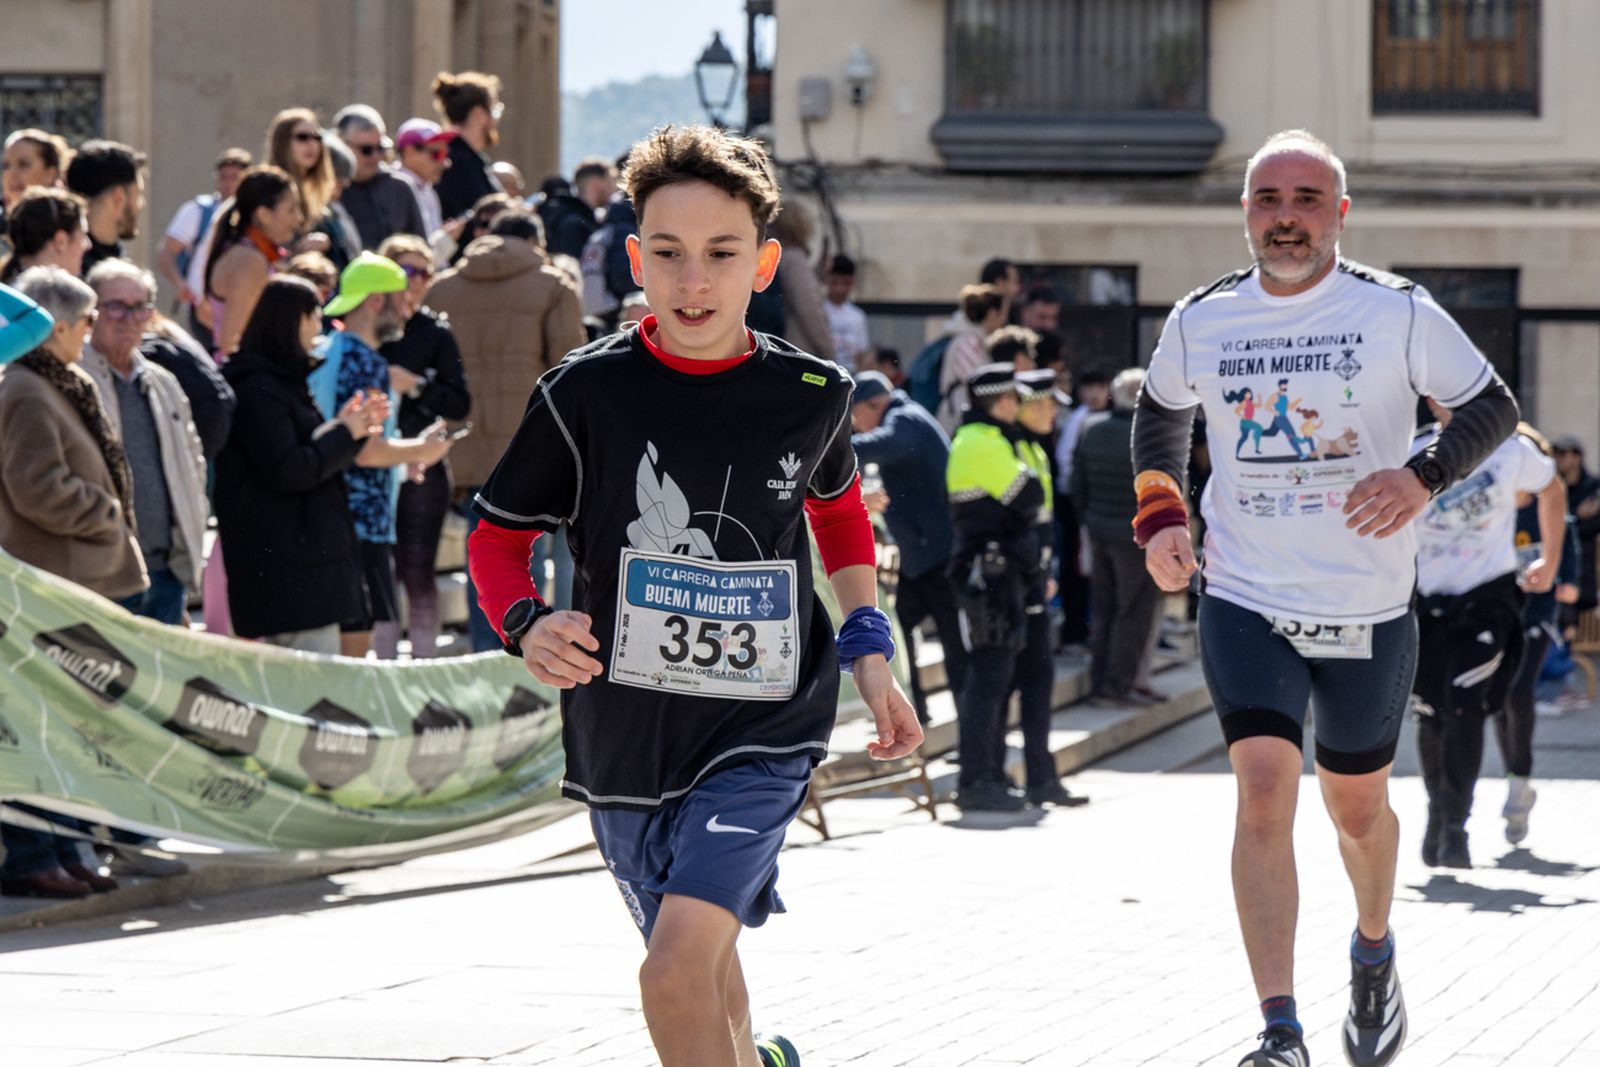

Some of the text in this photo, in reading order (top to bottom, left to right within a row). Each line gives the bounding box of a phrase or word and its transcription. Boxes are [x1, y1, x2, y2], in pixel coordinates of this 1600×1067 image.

[1221, 332, 1363, 352] VI CARRERA CAMINATA
[1218, 353, 1332, 377] BUENA MUERTE
[647, 566, 774, 590] VI CARRERA CAMINATA
[645, 583, 752, 615] BUENA MUERTE
[659, 614, 758, 670] 353
[664, 664, 694, 675] ADRIAN
[695, 667, 727, 678] ORTEGA
[189, 694, 257, 738] ownat
